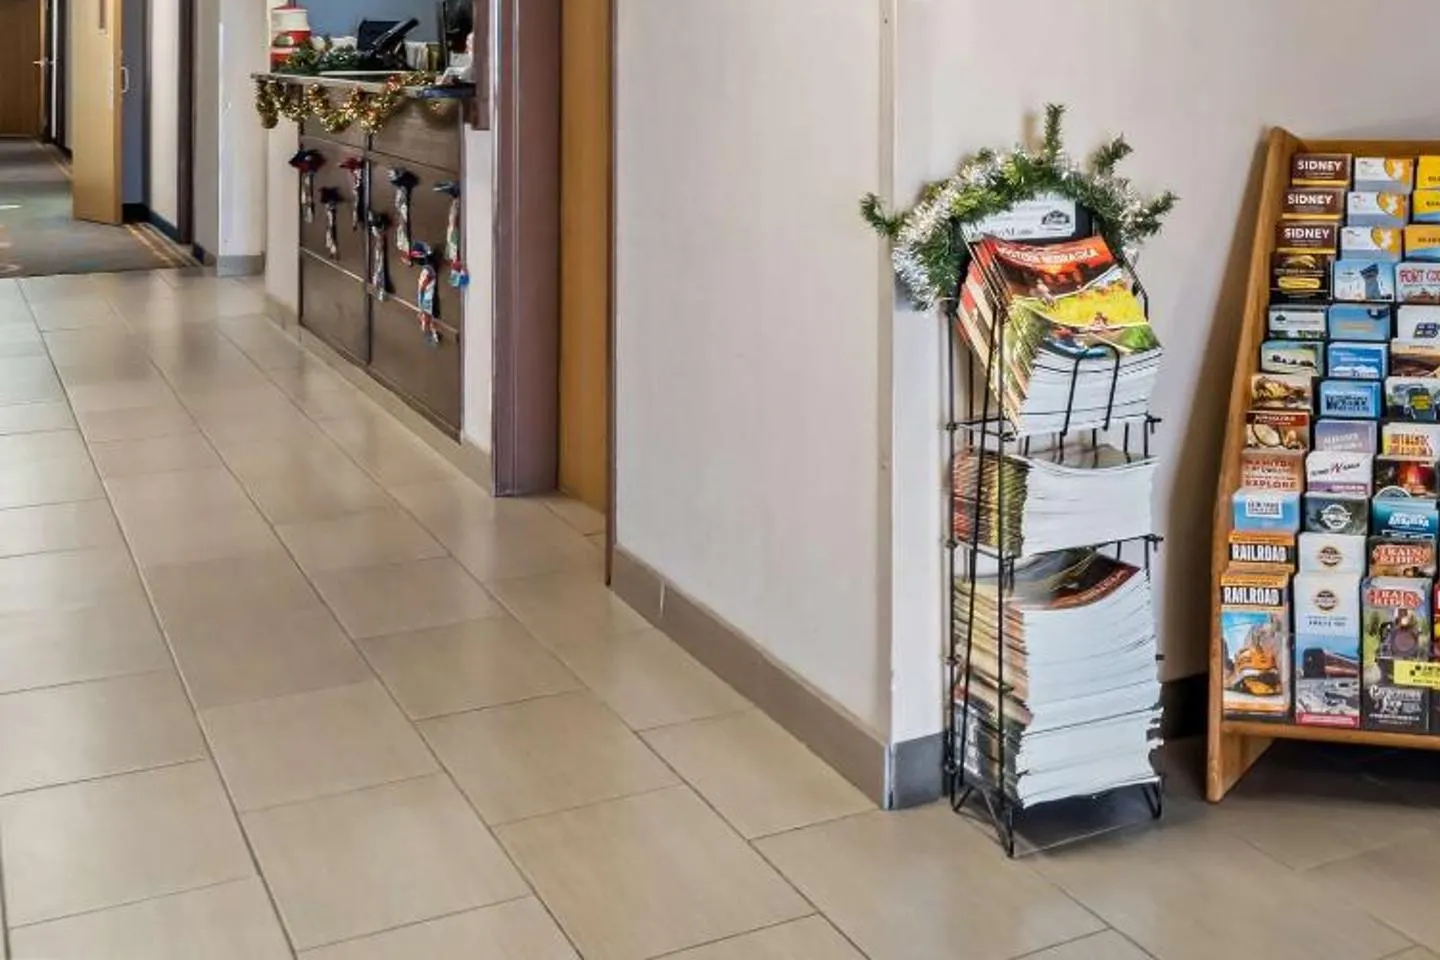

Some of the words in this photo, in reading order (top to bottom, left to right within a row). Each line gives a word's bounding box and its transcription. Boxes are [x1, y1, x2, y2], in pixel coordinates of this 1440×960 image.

[1297, 160, 1342, 171] SIDNEY
[1288, 194, 1333, 205] SIDNEY
[1284, 228, 1330, 239] SIDNEY
[1232, 544, 1286, 562] RAILROAD
[1224, 587, 1279, 605] RAILROAD
